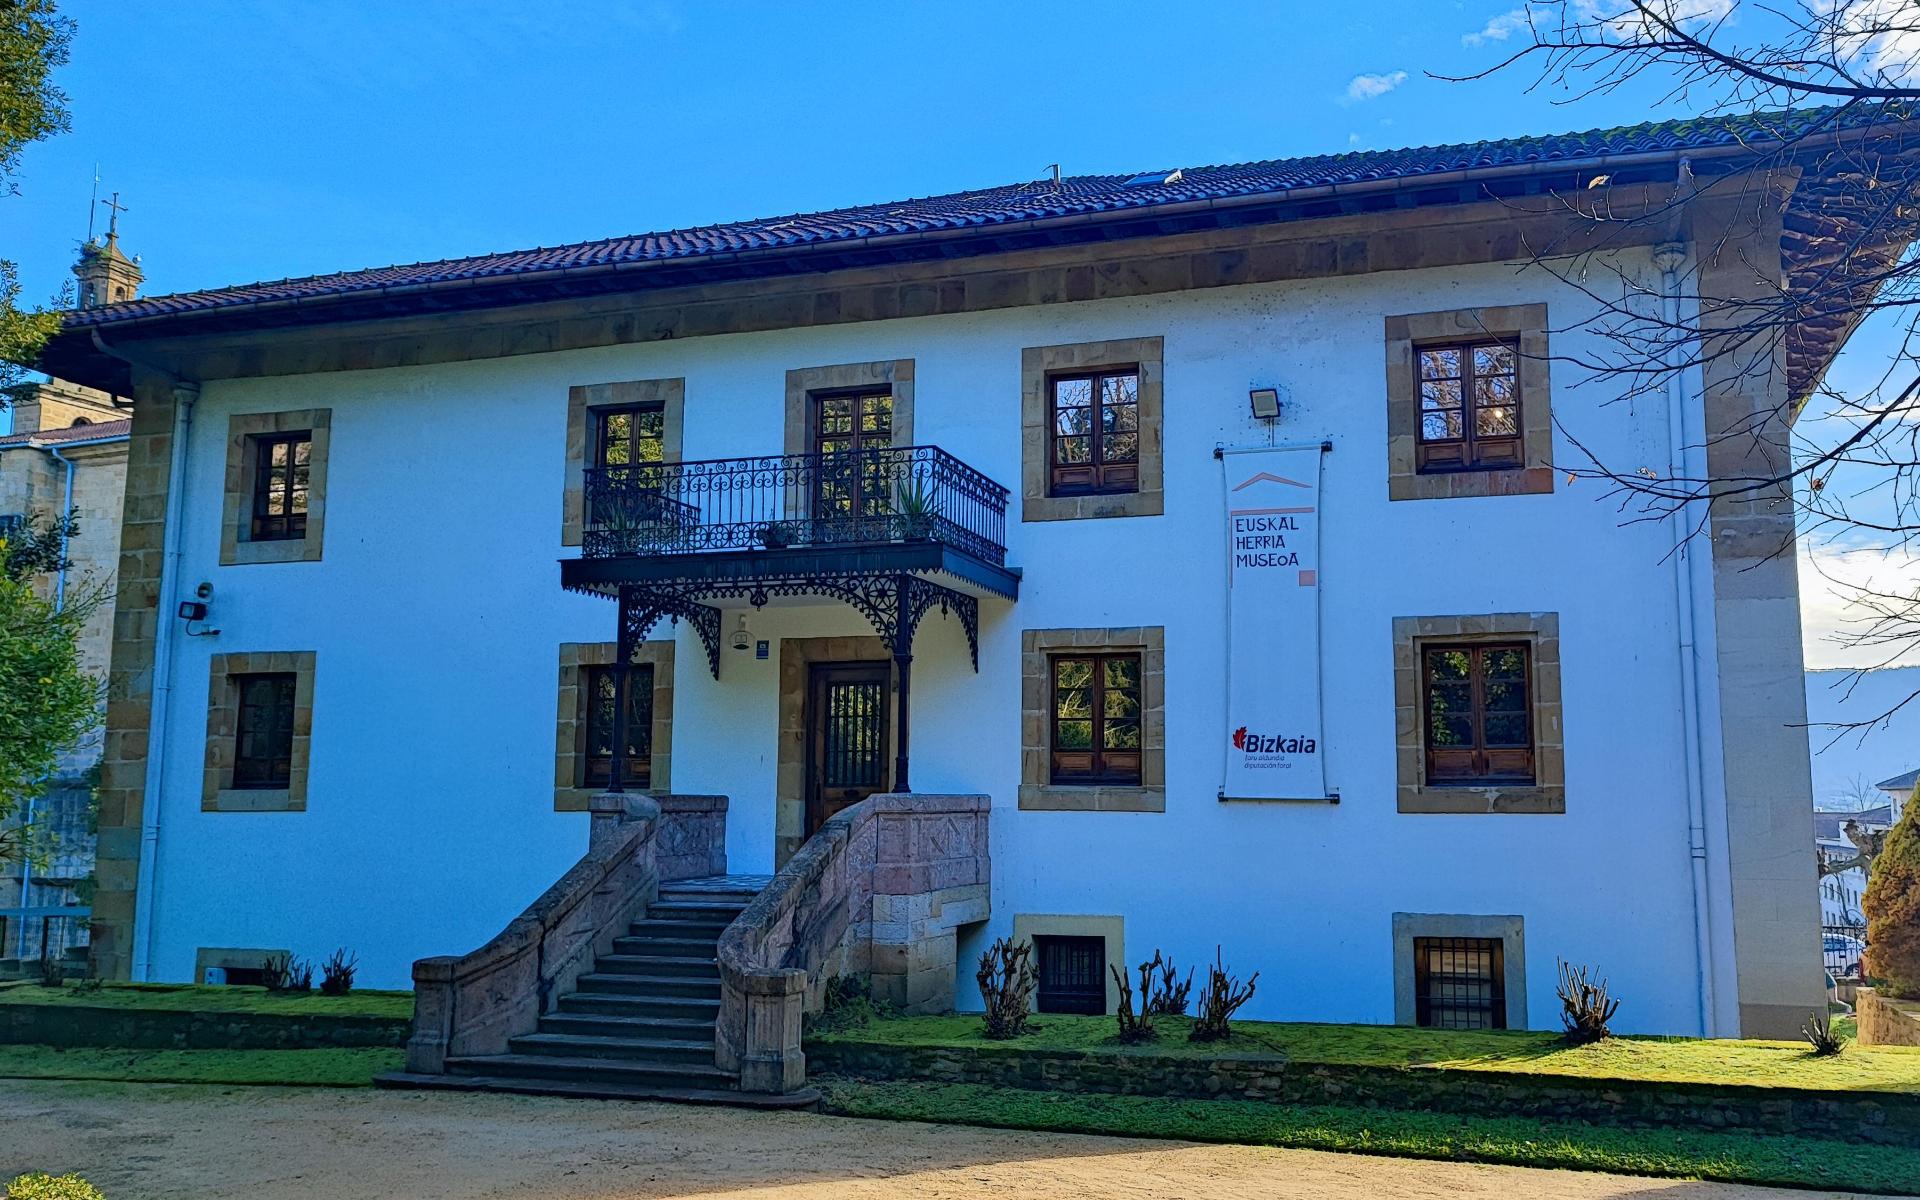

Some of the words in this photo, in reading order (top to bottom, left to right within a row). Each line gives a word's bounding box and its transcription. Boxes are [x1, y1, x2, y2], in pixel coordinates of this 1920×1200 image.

[1236, 516, 1299, 532] EUSKAL
[1236, 535, 1286, 550] HERRIA
[1246, 735, 1316, 754] Bizkaia
